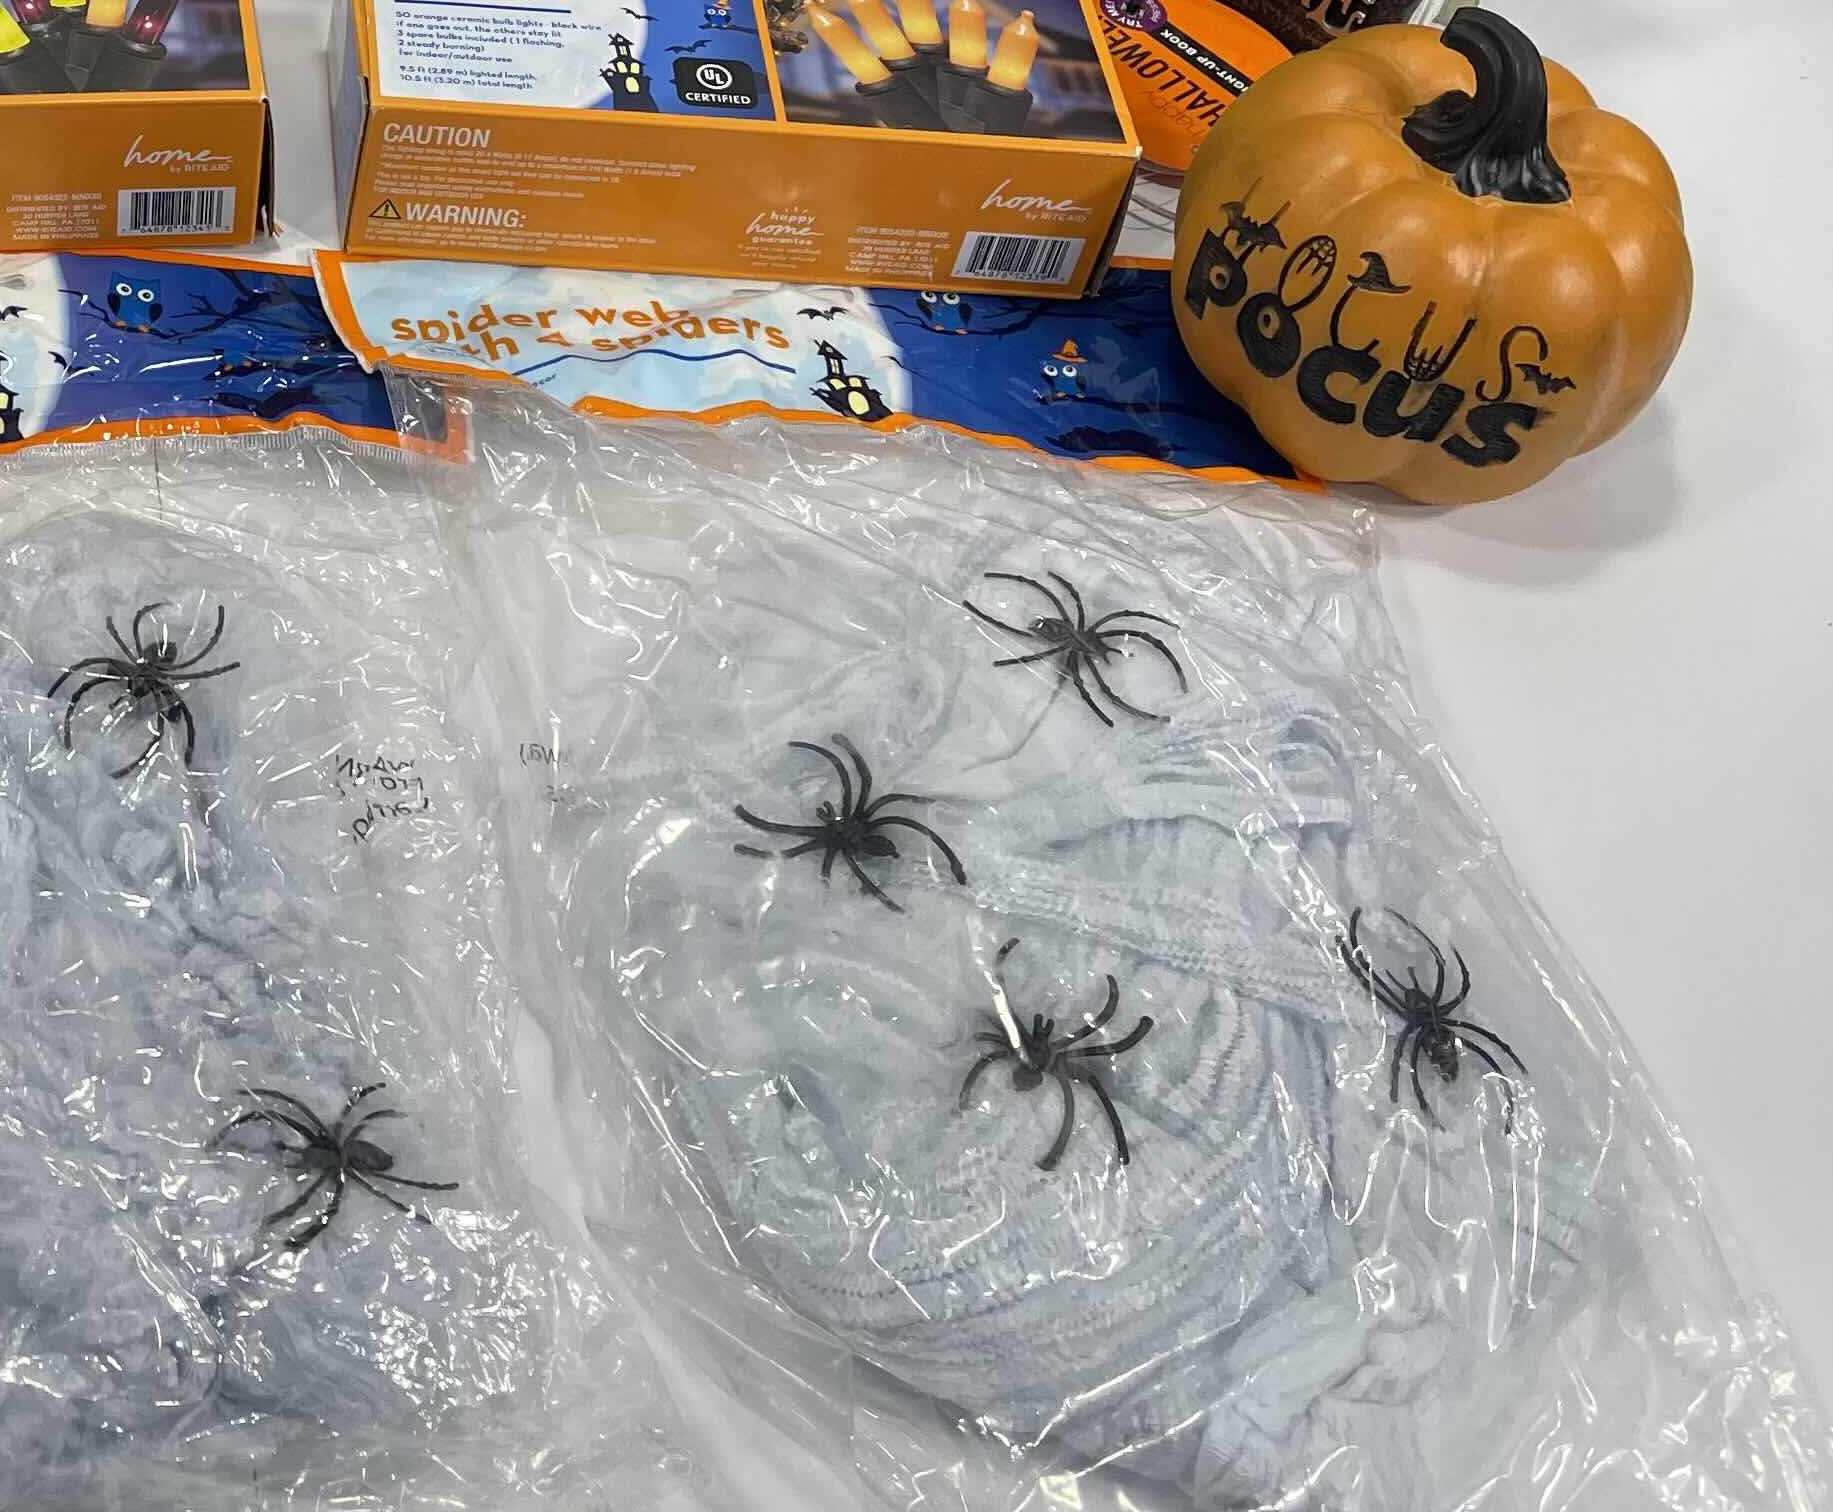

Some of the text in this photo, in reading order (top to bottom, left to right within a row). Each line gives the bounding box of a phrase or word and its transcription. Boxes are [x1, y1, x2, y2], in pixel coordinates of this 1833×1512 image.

[395, 10, 411, 19] 50
[413, 13, 449, 23] orange
[492, 17, 514, 27] bulb
[515, 18, 544, 29] lights
[551, 21, 578, 31] black
[1117, 13, 1144, 30] TRY
[406, 40, 441, 52] steady
[442, 42, 485, 54] burning)
[415, 50, 493, 63] indoor/outdoor
[495, 56, 513, 64] use
[1159, 28, 1249, 94] IGHT-UP BOOK
[685, 92, 752, 105] CERTIFIED
[382, 122, 492, 149] CAUTION
[123, 134, 233, 168] home
[980, 178, 1093, 212] home
[405, 201, 528, 230] WARNING:
[745, 212, 825, 237] home
[770, 211, 816, 224] happy
[751, 236, 813, 246] guarantee
[391, 300, 690, 344] spider web
